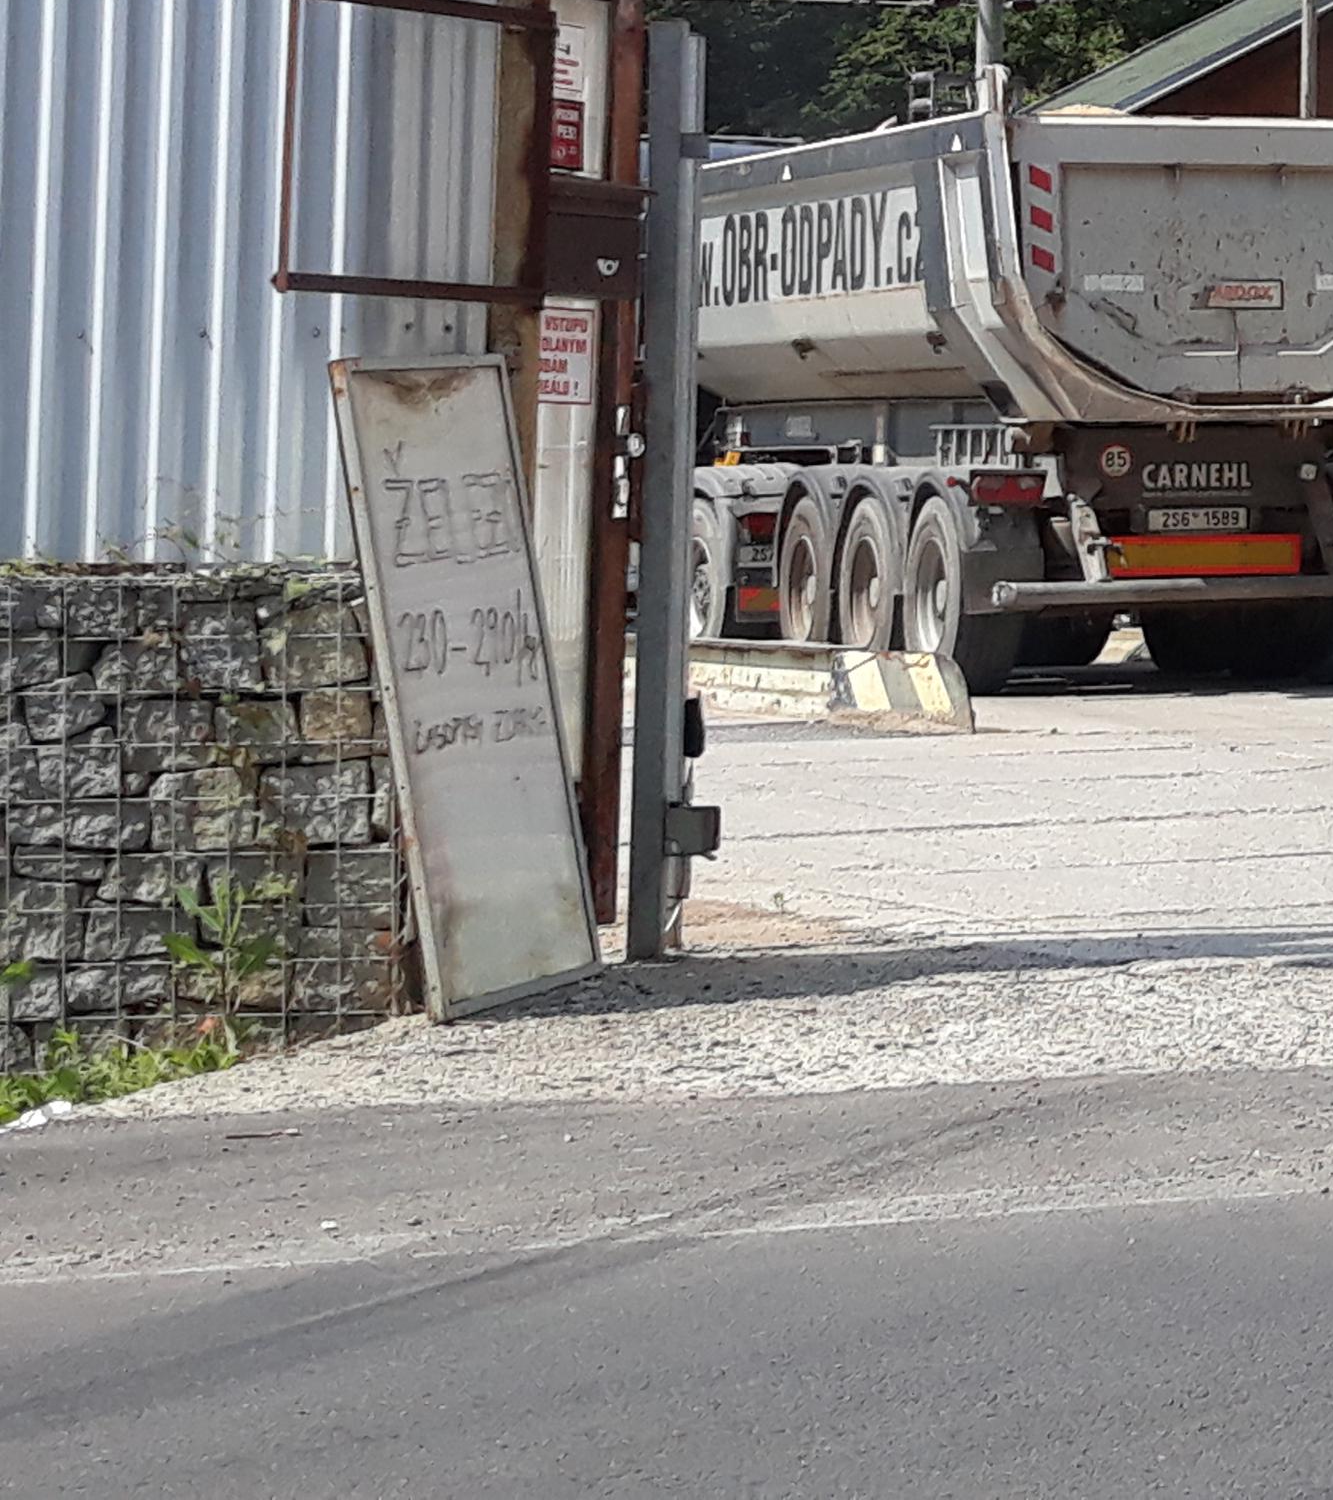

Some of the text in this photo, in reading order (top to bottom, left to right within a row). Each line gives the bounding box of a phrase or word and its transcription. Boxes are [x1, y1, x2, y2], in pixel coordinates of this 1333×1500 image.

[1105, 451, 1127, 468] 85
[1142, 463, 1252, 489] CARNEHL
[1162, 510, 1240, 528] 2S6 1589
